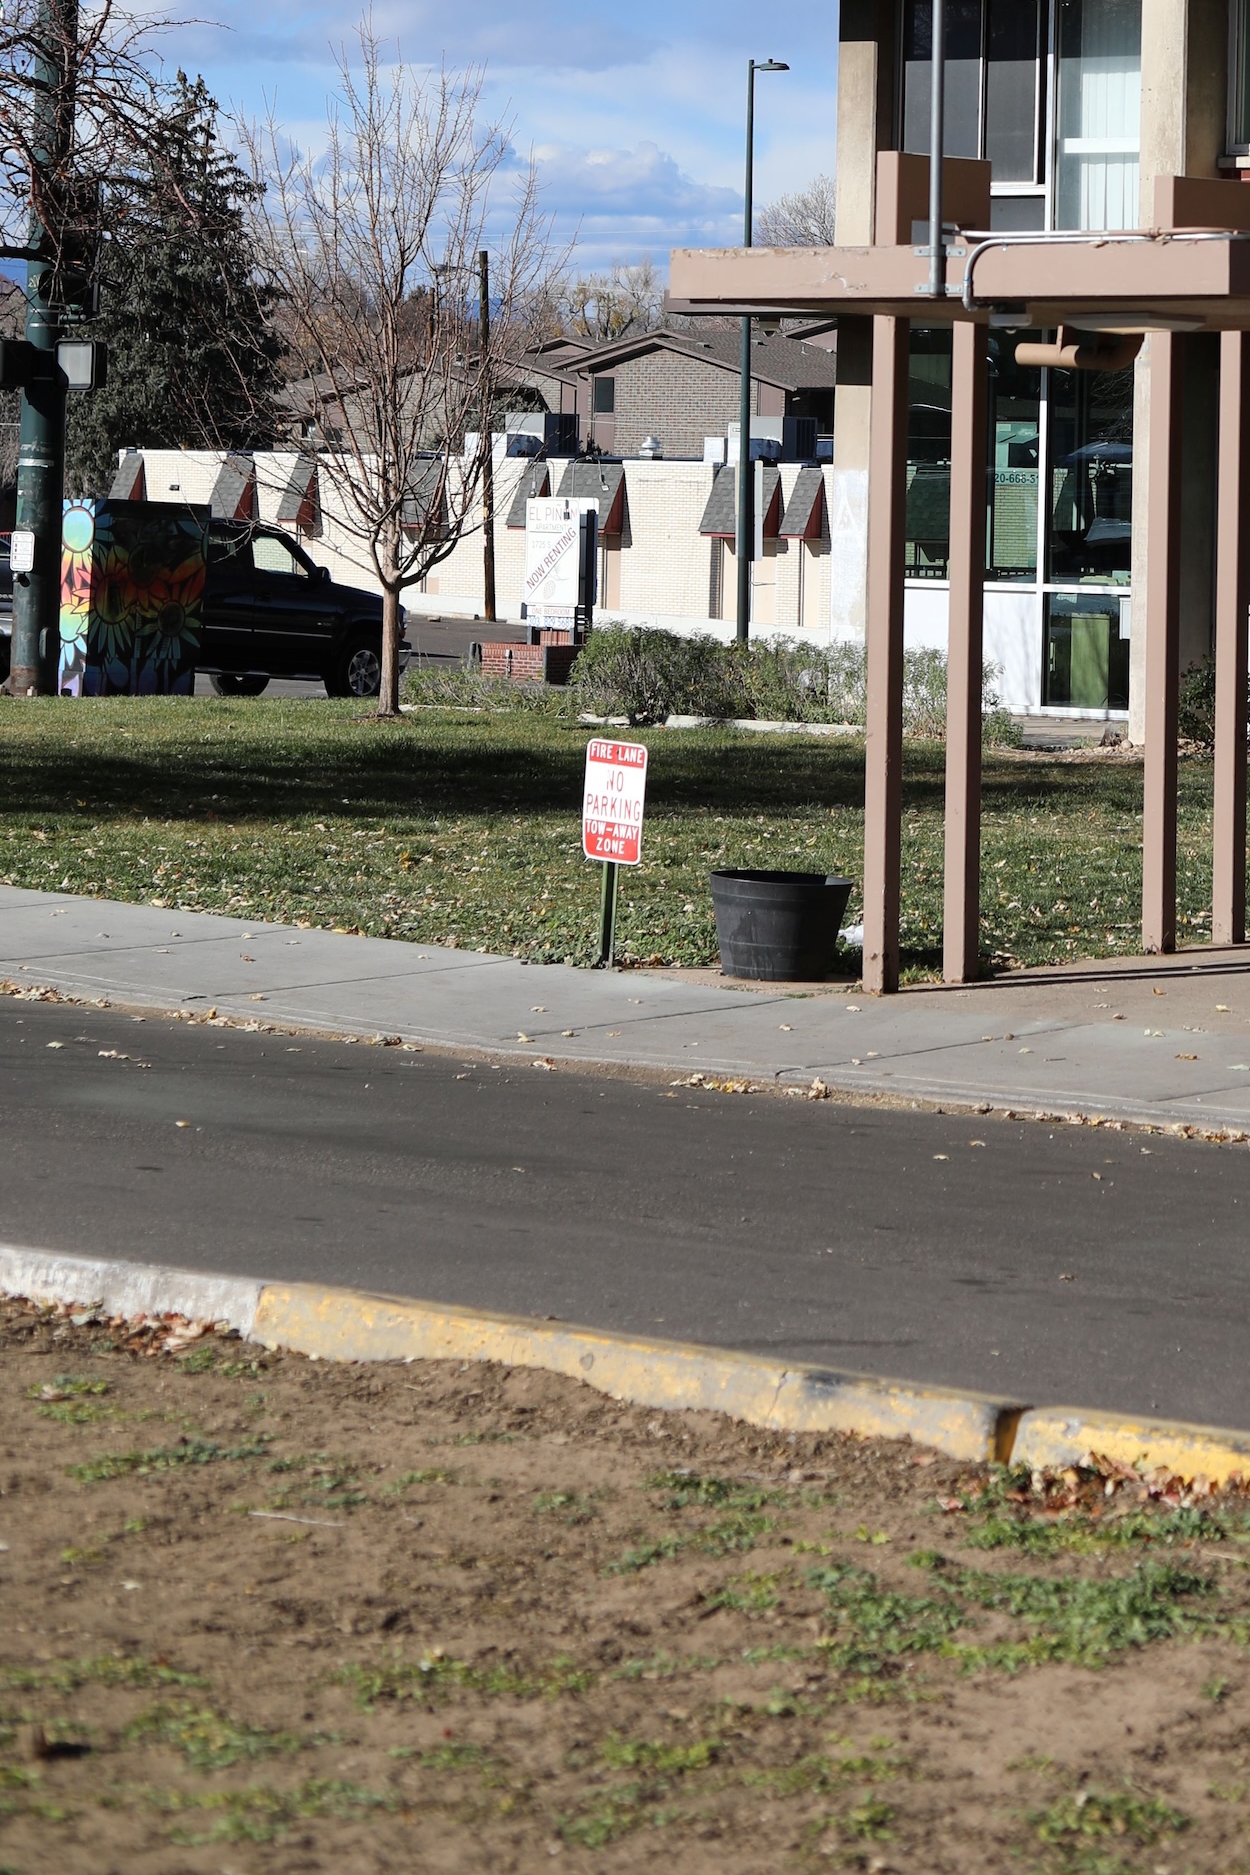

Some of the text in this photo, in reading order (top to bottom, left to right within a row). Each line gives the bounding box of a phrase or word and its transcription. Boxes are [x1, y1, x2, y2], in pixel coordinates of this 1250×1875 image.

[529, 503, 578, 522] EL PIÑN
[535, 523, 569, 531] APARTMENT
[526, 564, 545, 589] NOW
[543, 527, 577, 568] RENTING
[531, 607, 571, 616] ONE BEDROOM
[591, 743, 643, 763] FIRE LANE
[606, 770, 624, 792] NO
[586, 794, 640, 821] PARKING
[586, 820, 639, 840] TOW-AWAY
[596, 838, 625, 854] ZONE
